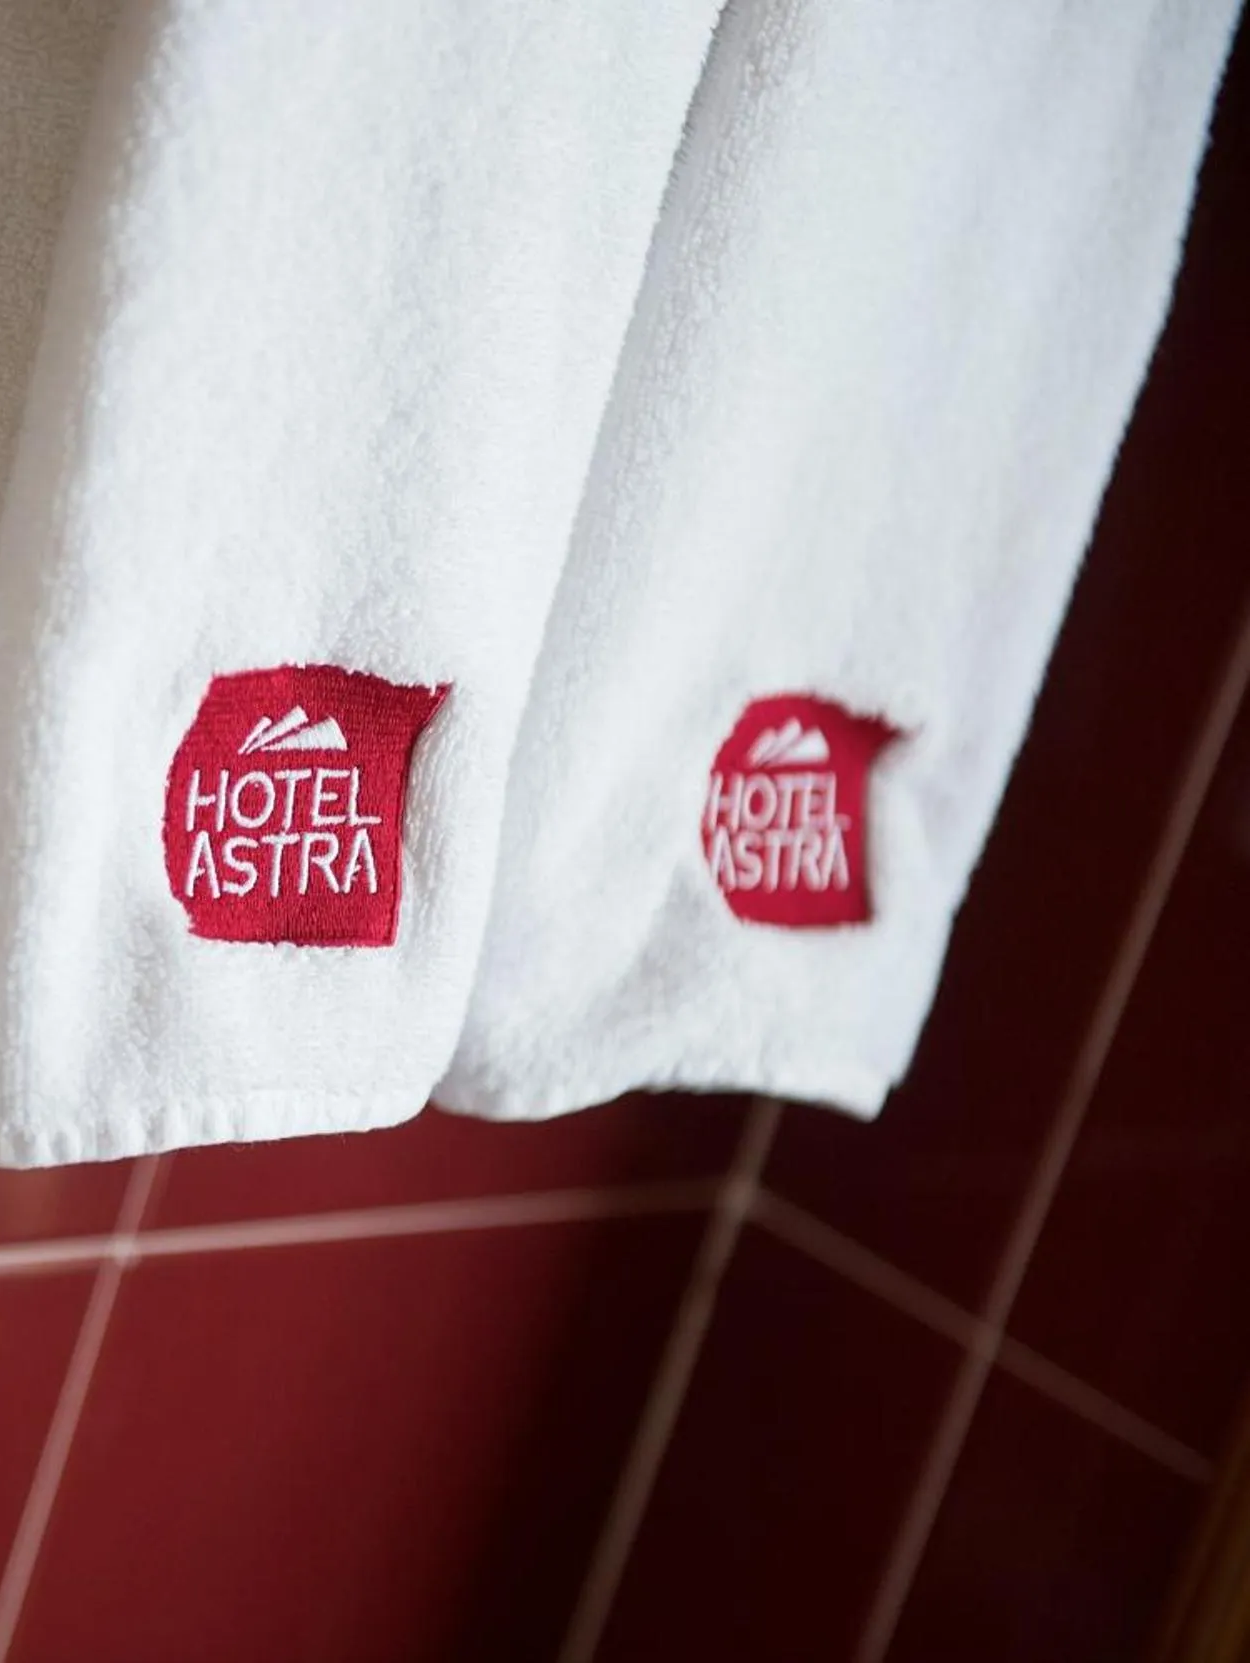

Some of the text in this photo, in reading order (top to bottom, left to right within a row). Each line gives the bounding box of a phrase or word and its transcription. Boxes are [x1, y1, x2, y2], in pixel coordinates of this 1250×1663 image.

[186, 767, 382, 832] HOTEL
[703, 772, 852, 834] HOTEL
[185, 829, 378, 899] ASTRA
[710, 825, 850, 892] ASTRA
